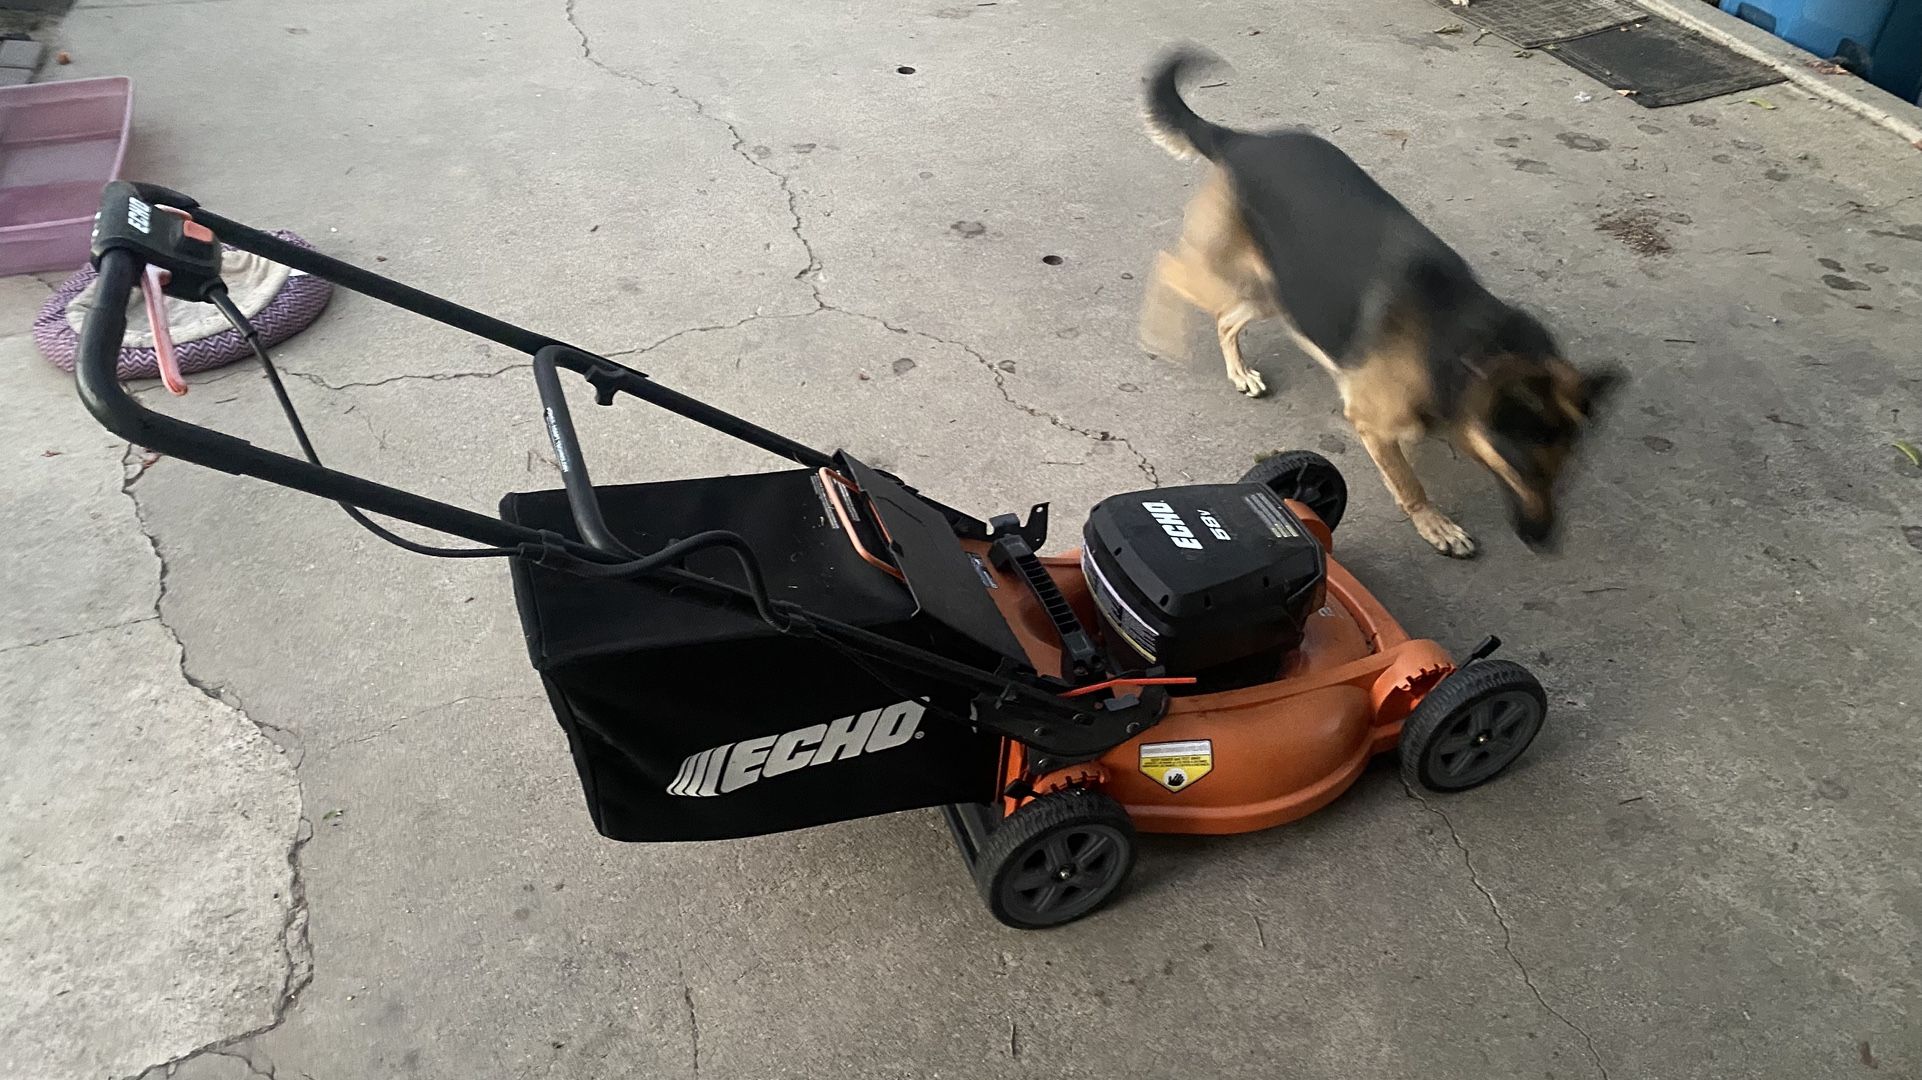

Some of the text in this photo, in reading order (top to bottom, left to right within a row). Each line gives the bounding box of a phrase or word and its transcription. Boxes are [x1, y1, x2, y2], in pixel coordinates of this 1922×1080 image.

[128, 196, 150, 234] ECHO
[1142, 502, 1203, 549] ECHO
[1197, 509, 1231, 540] 58V
[720, 700, 926, 793] ECHO
